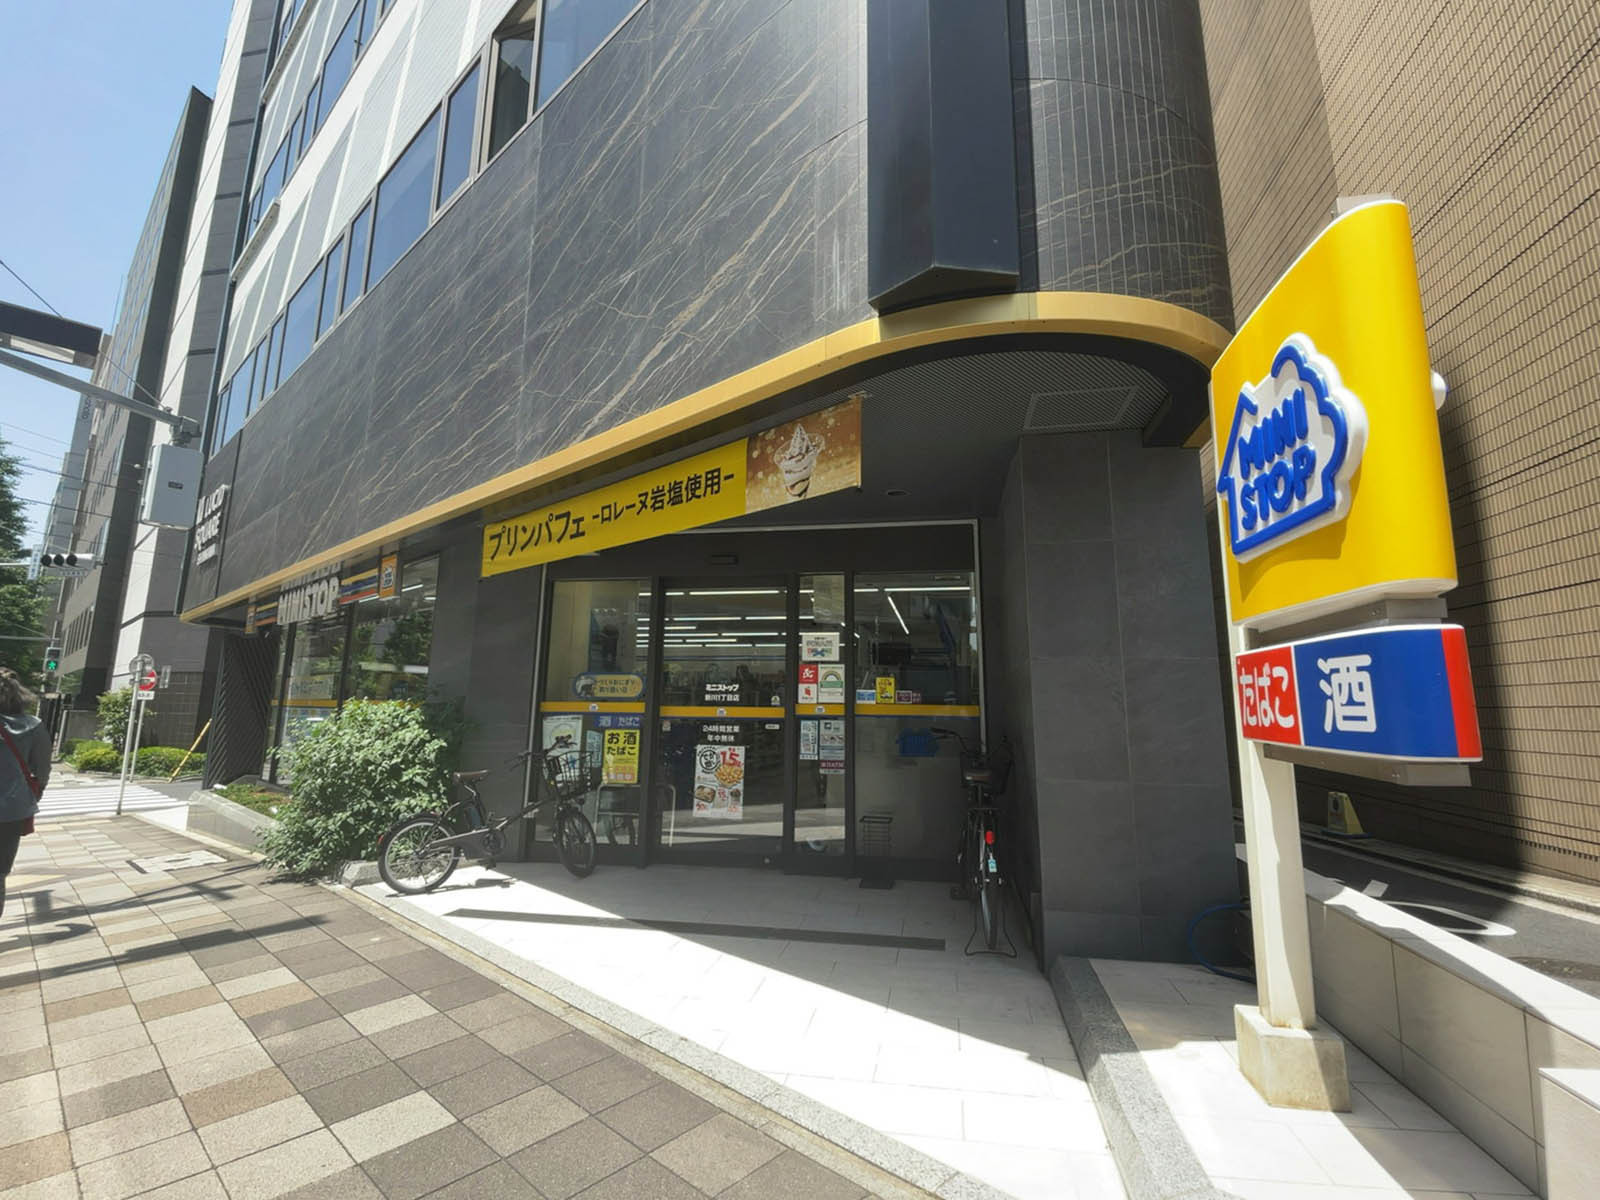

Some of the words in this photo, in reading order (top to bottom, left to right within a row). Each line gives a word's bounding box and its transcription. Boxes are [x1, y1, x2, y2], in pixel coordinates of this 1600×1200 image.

[1237, 387, 1309, 480] MINI
[1241, 443, 1317, 531] STOP
[489, 510, 586, 560] プリンパフェ
[277, 576, 340, 626] MINISTOP
[705, 684, 739, 692] ミニストップ
[1239, 661, 1295, 729] たばこ
[1317, 653, 1378, 733] 酒
[606, 746, 636, 756] たばこ
